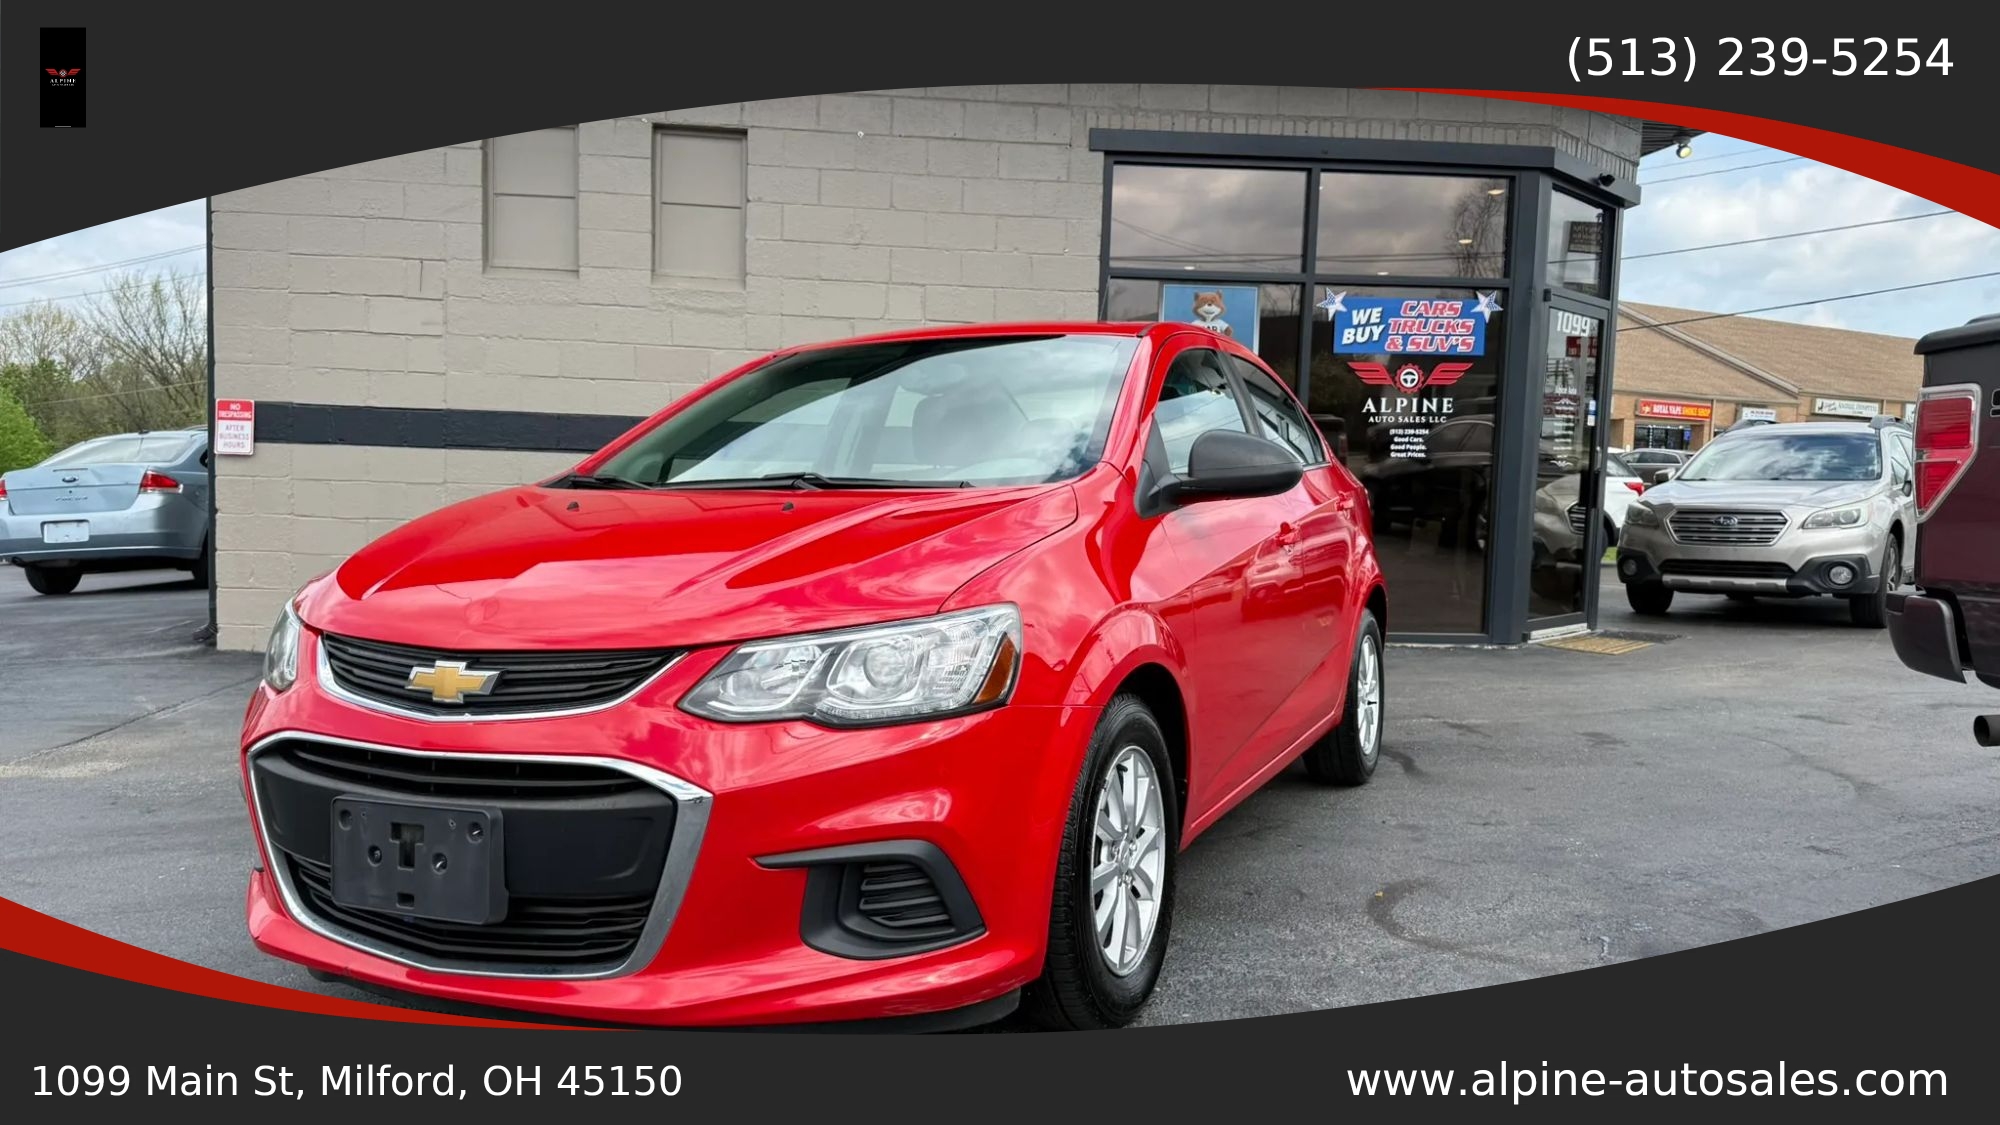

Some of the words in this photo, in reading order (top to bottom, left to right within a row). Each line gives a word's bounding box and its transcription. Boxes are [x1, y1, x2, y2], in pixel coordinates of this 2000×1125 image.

[1352, 307, 1383, 325] WE
[1400, 300, 1463, 317] CARS
[1388, 318, 1475, 335] TRUCKS
[1556, 311, 1591, 337] 1099
[1342, 324, 1385, 345] BUY
[1384, 336, 1403, 352] &
[1405, 336, 1475, 353] SUV'S
[1361, 397, 1454, 413] ALPINE
[1669, 405, 1681, 415] VAPE
